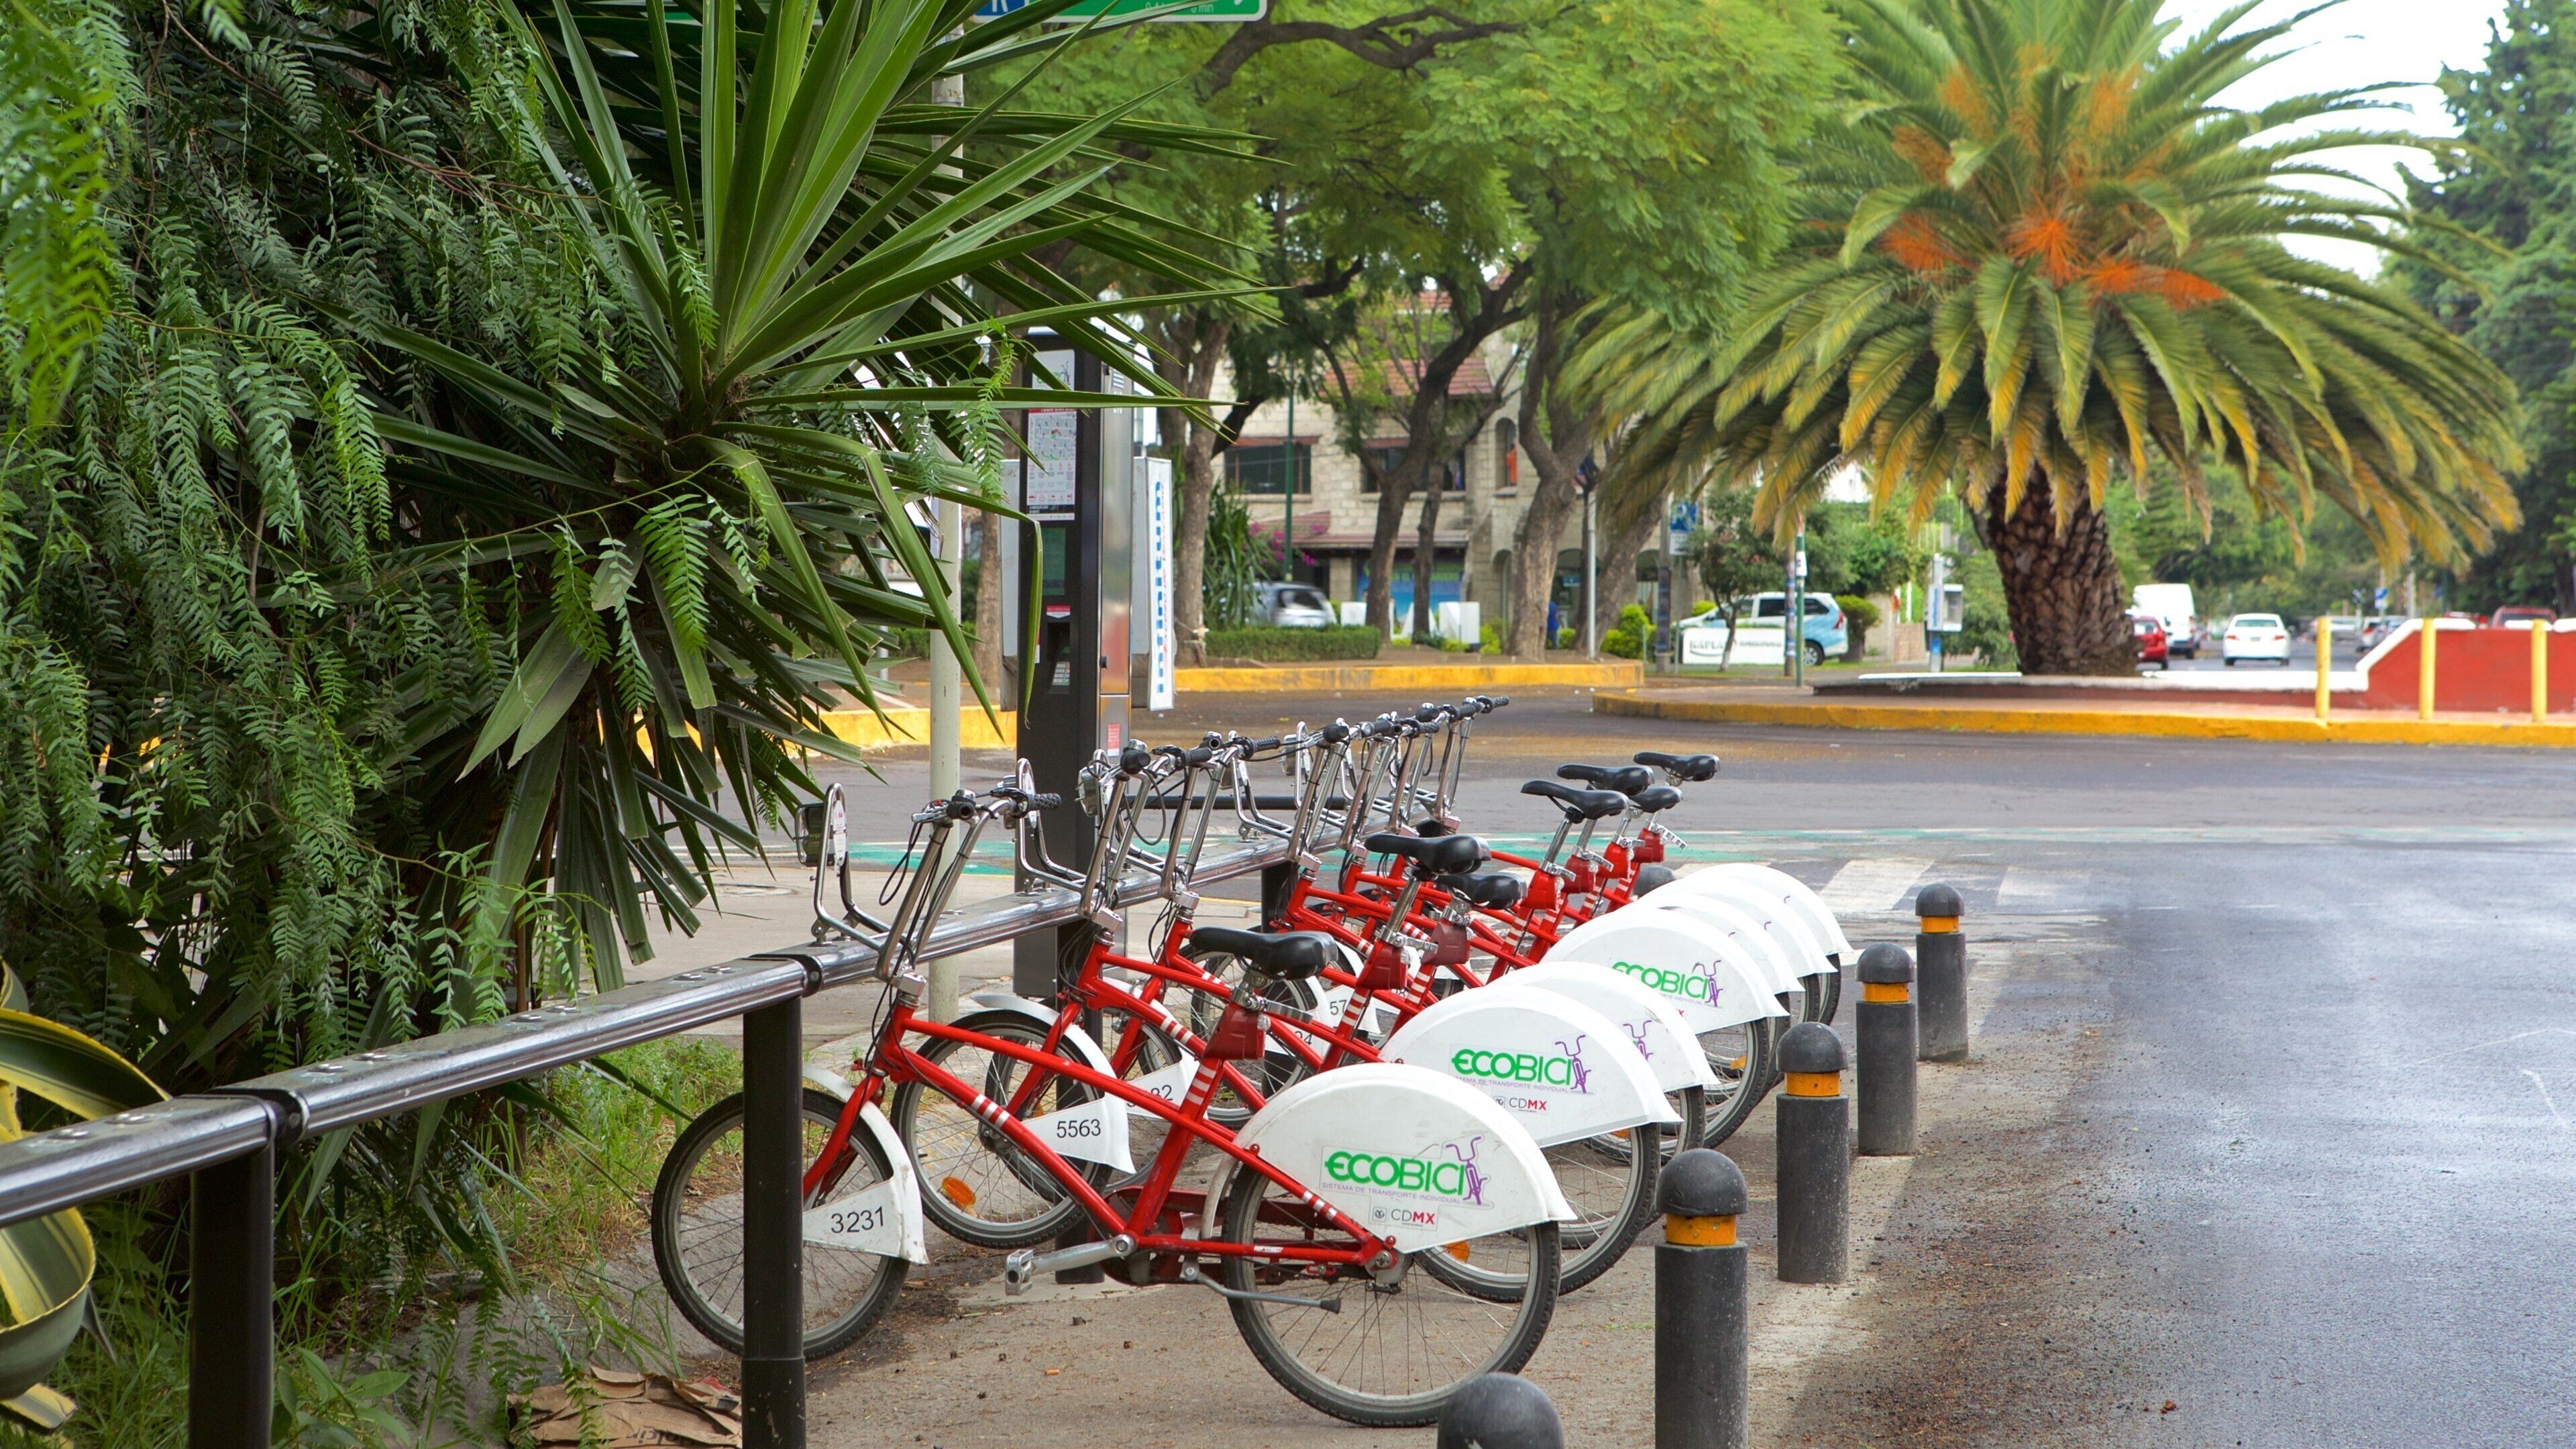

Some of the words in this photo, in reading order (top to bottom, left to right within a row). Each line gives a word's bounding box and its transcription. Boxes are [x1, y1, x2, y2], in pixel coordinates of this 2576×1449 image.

[1330, 1000, 1347, 1015] 57
[1452, 1049, 1572, 1085] ECOBICI
[1488, 1080, 1531, 1089] TRANSPORTE
[1533, 1085, 1569, 1093] INDIVIDUAL
[1509, 1097, 1547, 1111] CDMX
[1057, 1119, 1101, 1138] 5563
[1325, 1151, 1465, 1195] ECOBICI
[1322, 1183, 1353, 1191] SISTEMA
[1355, 1185, 1365, 1193] DE
[1368, 1187, 1417, 1199] TRANSPORTE
[1419, 1194, 1461, 1204] INDIVIDUAL
[831, 1206, 883, 1233] 3231
[1391, 1209, 1436, 1224] CDMX
